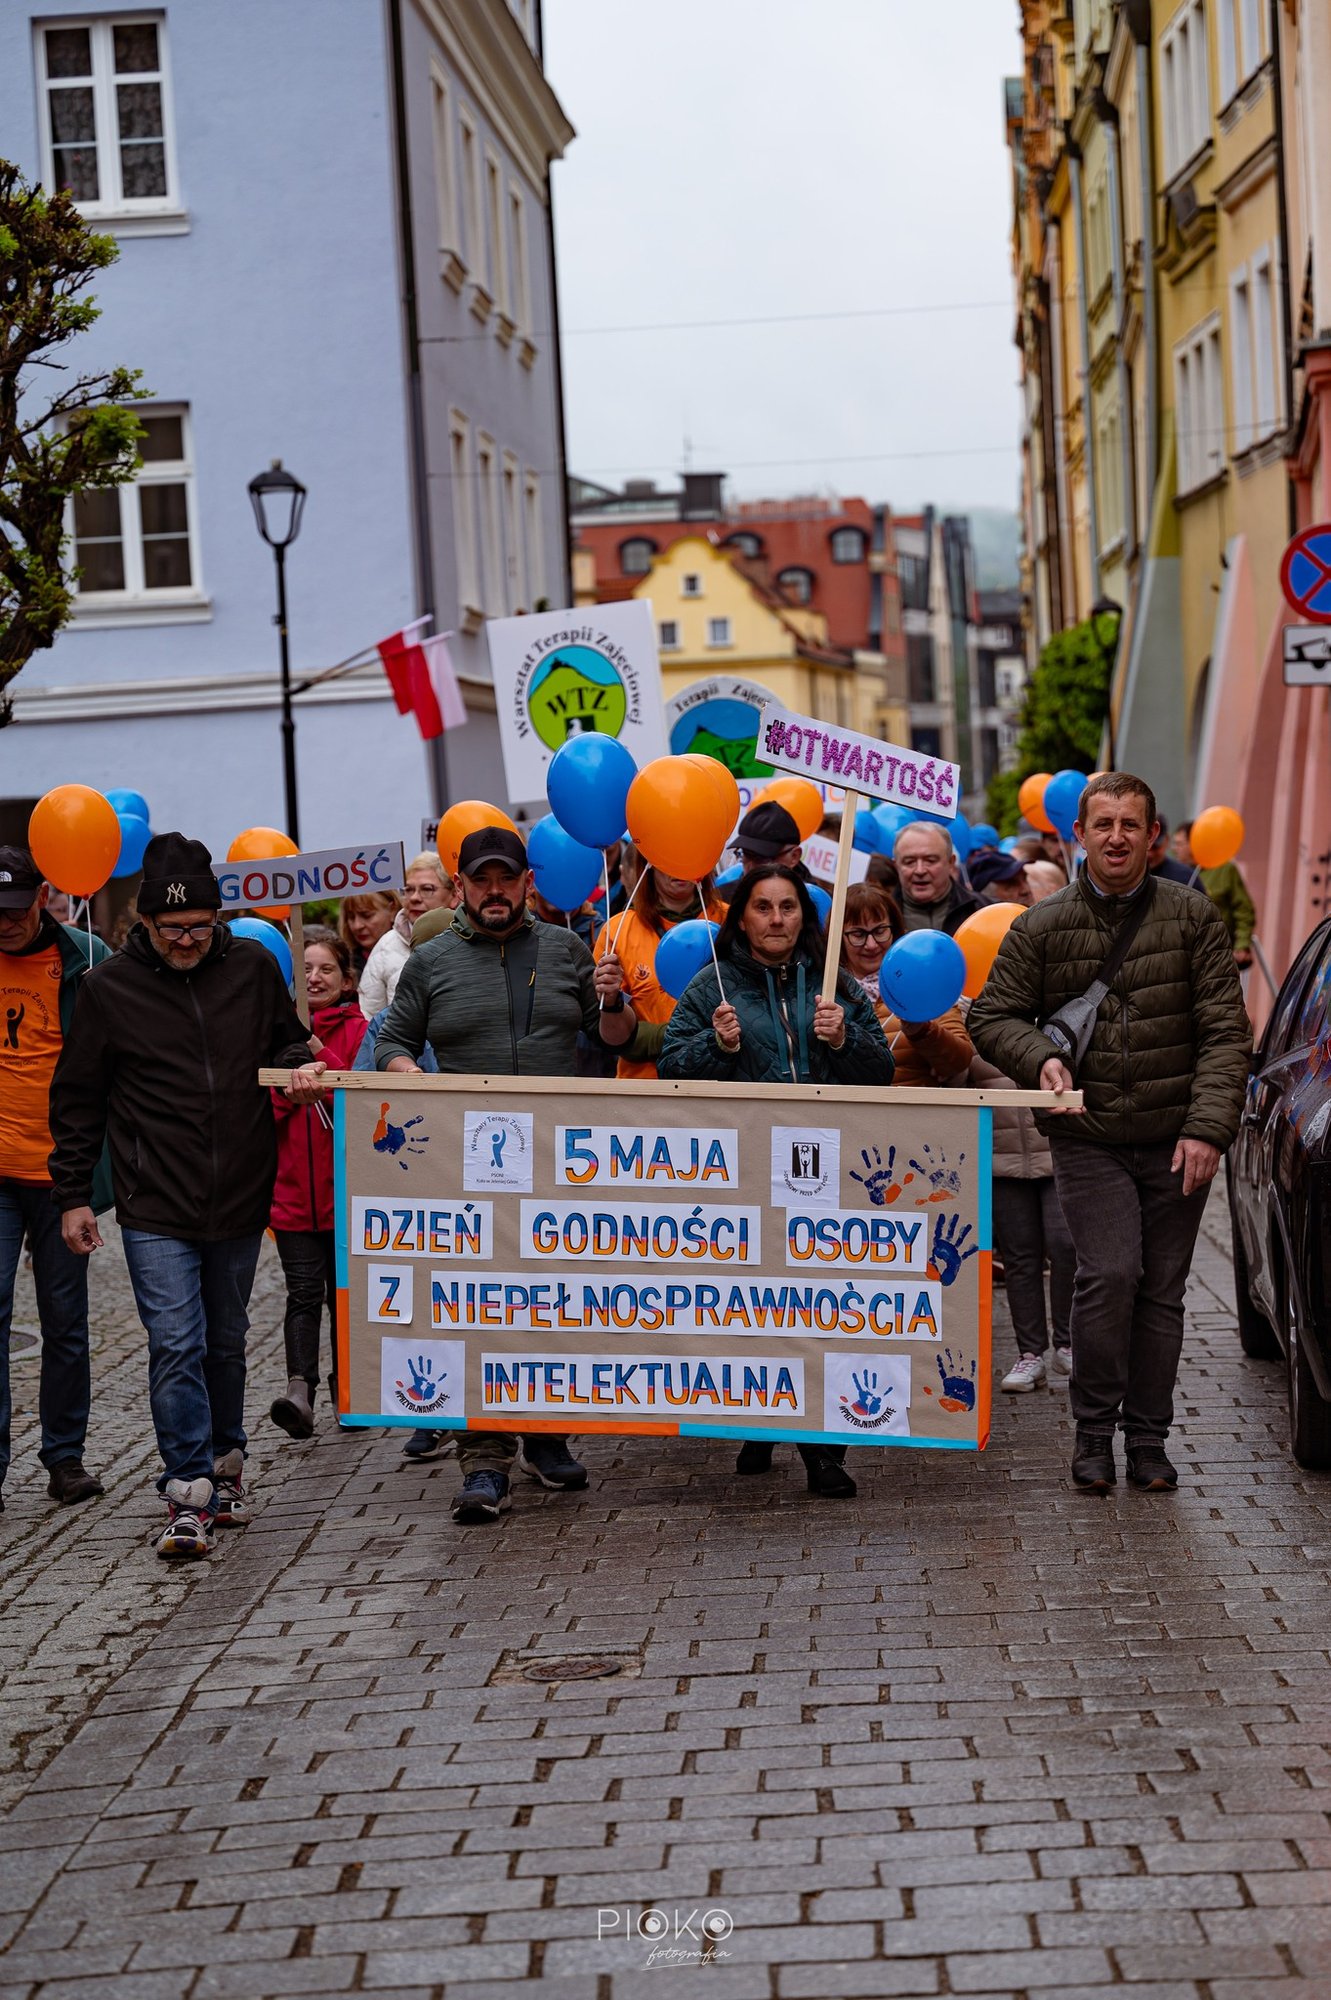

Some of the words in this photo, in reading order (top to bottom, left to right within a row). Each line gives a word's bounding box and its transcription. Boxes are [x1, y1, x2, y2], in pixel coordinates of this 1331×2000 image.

[514, 654, 536, 740] Warsztat
[531, 626, 593, 654] Terapii
[545, 687, 609, 717] WTZ
[764, 719, 954, 807] #OTWARTOŚĆ
[166, 882, 187, 904] NY
[218, 849, 392, 901] GODNOŚĆ
[565, 1128, 599, 1184] 5
[610, 1134, 729, 1182] MAJA
[363, 1203, 482, 1254] DZIEŃ
[532, 1205, 749, 1261] GODNOŚCI
[788, 1216, 922, 1264] OSOBY
[378, 1276, 401, 1317] Z
